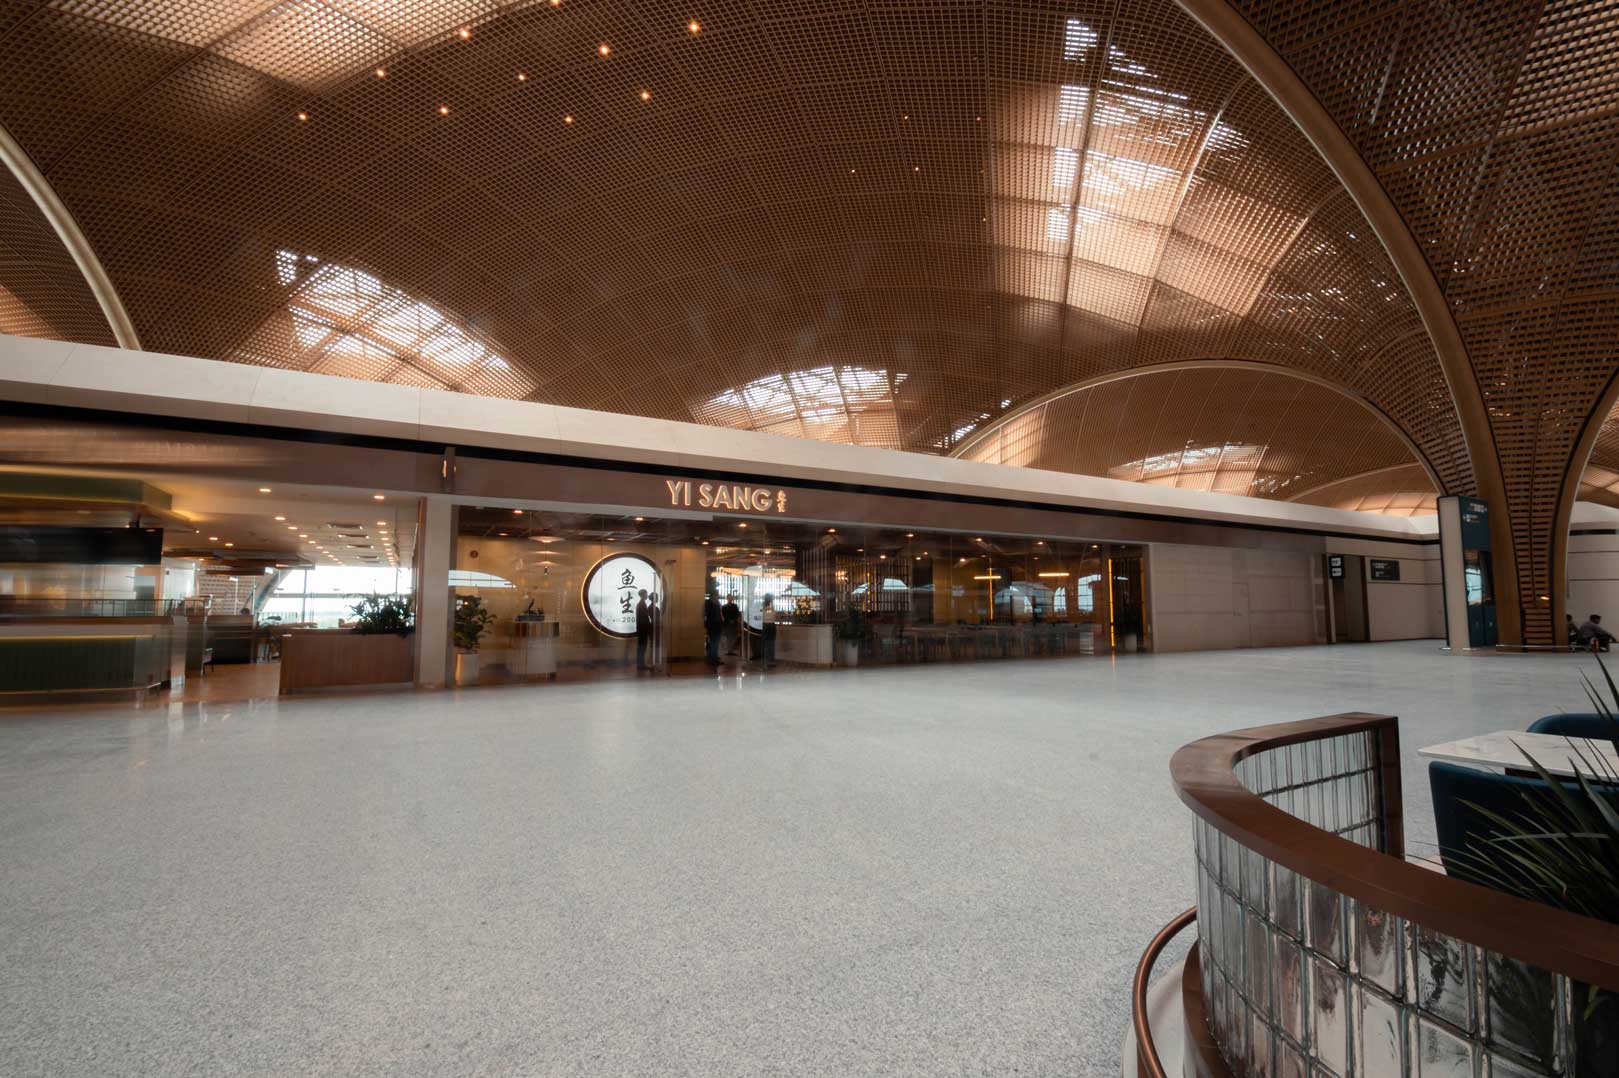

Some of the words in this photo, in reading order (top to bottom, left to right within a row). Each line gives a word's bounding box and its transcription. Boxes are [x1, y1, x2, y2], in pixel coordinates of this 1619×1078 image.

[666, 480, 691, 506] YI
[698, 483, 773, 511] SANG
[617, 568, 638, 614] 鱼生
